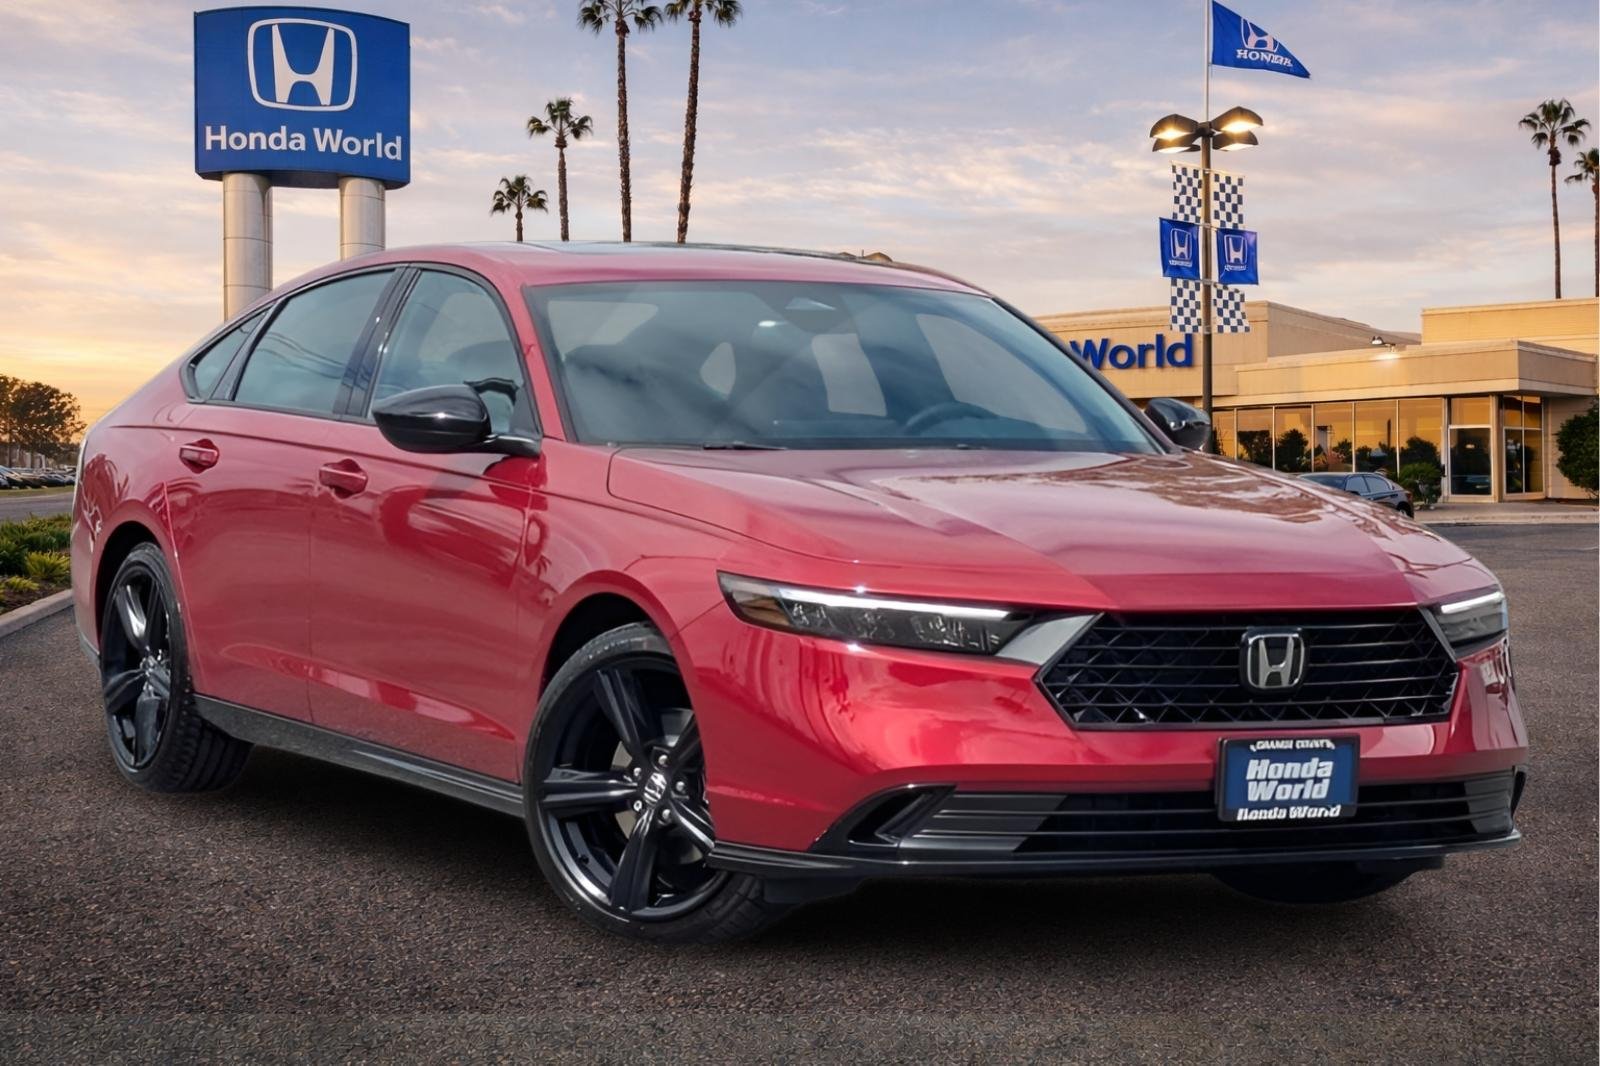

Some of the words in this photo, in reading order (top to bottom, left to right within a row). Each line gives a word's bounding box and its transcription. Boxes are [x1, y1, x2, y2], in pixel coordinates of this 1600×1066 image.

[205, 125, 306, 151] Honda
[313, 127, 402, 161] World
[1069, 333, 1193, 370] World
[1246, 757, 1334, 780] Honda
[1247, 779, 1331, 801] World
